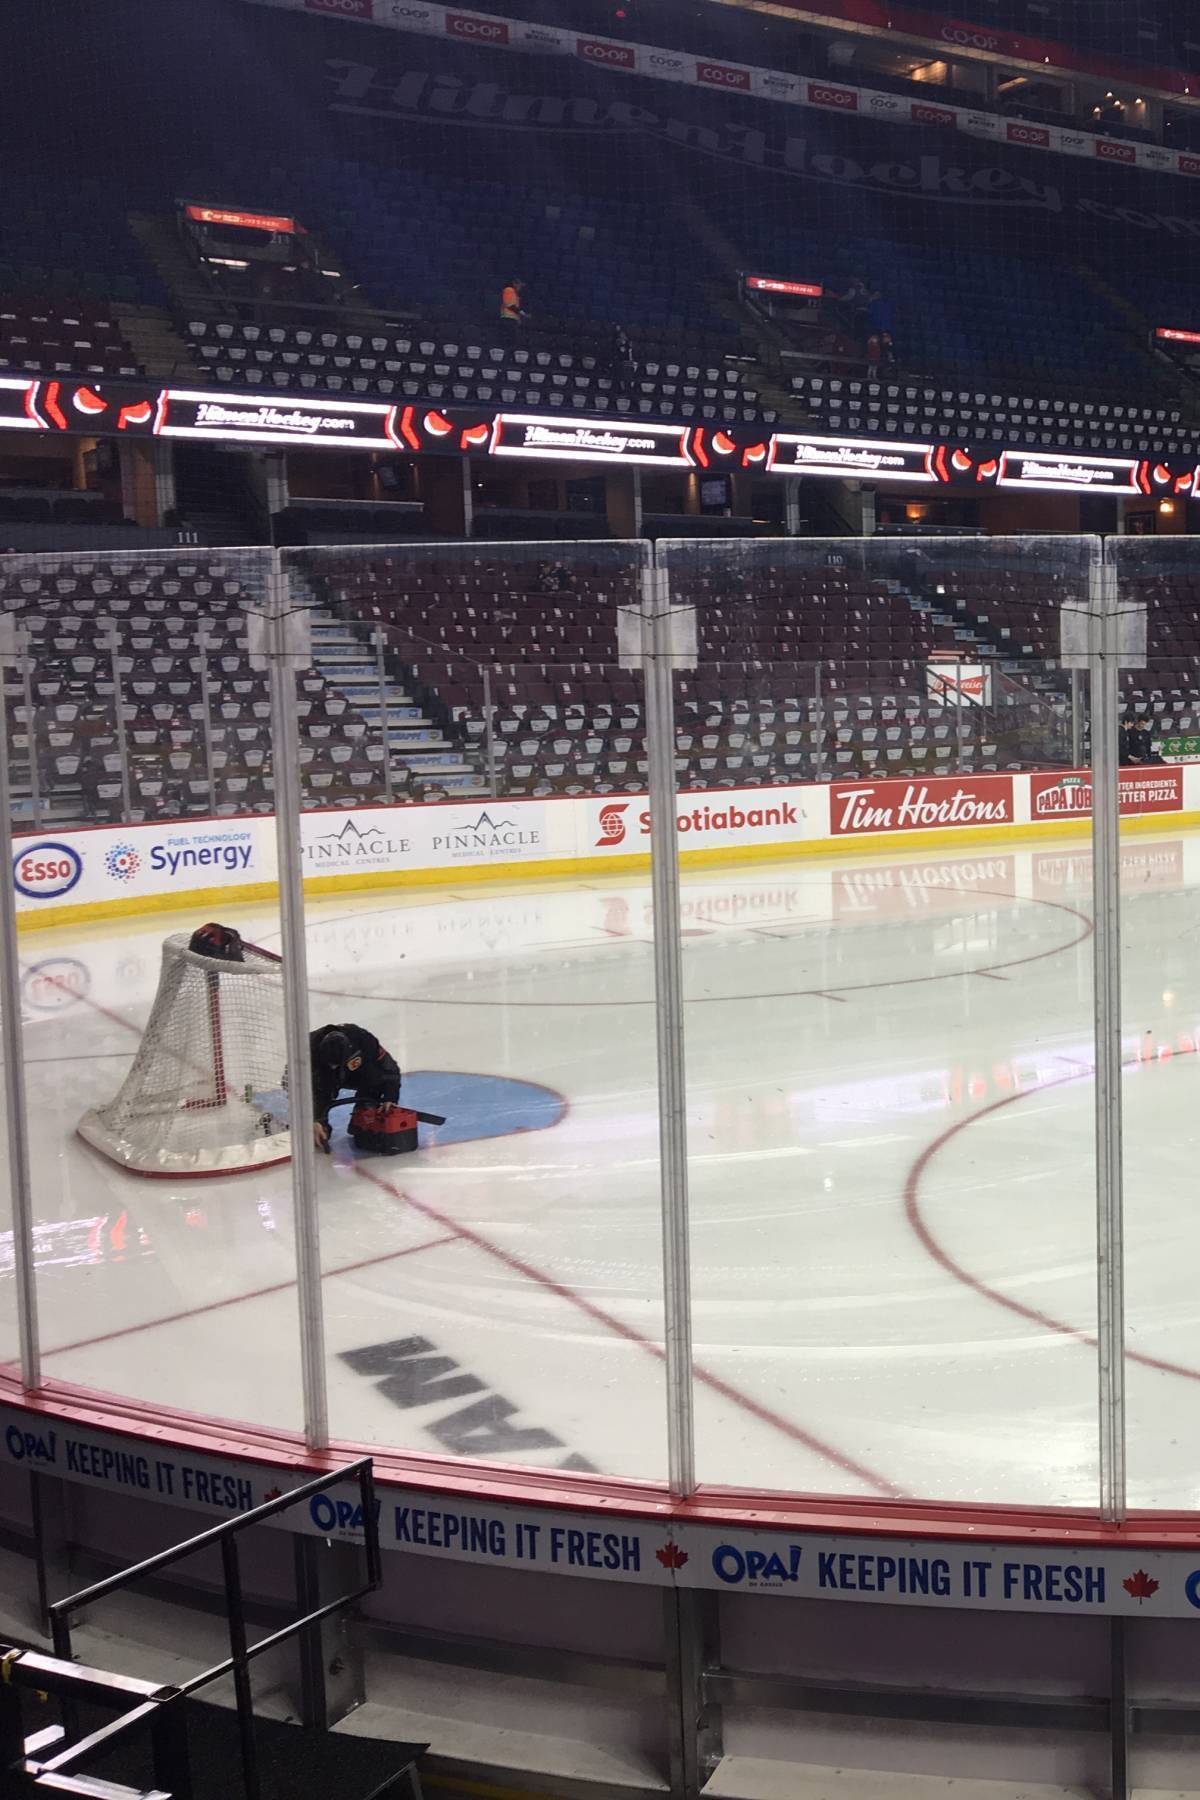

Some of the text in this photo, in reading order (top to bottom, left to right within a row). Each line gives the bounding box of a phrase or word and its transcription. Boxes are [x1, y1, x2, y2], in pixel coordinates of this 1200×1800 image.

[453, 20, 501, 37] CO-OP
[583, 44, 629, 62] CO-OP
[702, 68, 745, 85] CO-OP
[814, 88, 852, 104] CO-OP
[917, 109, 952, 124] CO-OP
[1011, 128, 1046, 142] CO-OP
[1100, 144, 1132, 158] CO-OP
[193, 403, 355, 433] HitmenHockey.com
[523, 426, 655, 453] HitmenHockey.com
[177, 531, 199, 544] 111
[1135, 779, 1178, 789] INGREDIENTS.
[1038, 787, 1068, 811] PAPA
[1148, 789, 1178, 802] PIZZA.
[836, 785, 1006, 830] Tim Hortons
[639, 801, 797, 835] Sotiabank
[167, 832, 251, 846] FUEL TECHNOLOGY
[432, 830, 540, 850] PINNACLE
[150, 845, 252, 876] Synergy
[6, 1424, 254, 1512] OPA! KEEPING IT FRESH
[394, 1505, 505, 1557] KEEPING
[514, 1522, 540, 1561] IT
[549, 1526, 641, 1572] FRESH
[712, 1544, 1106, 1603] OPA! KEEPING IT FRESH
